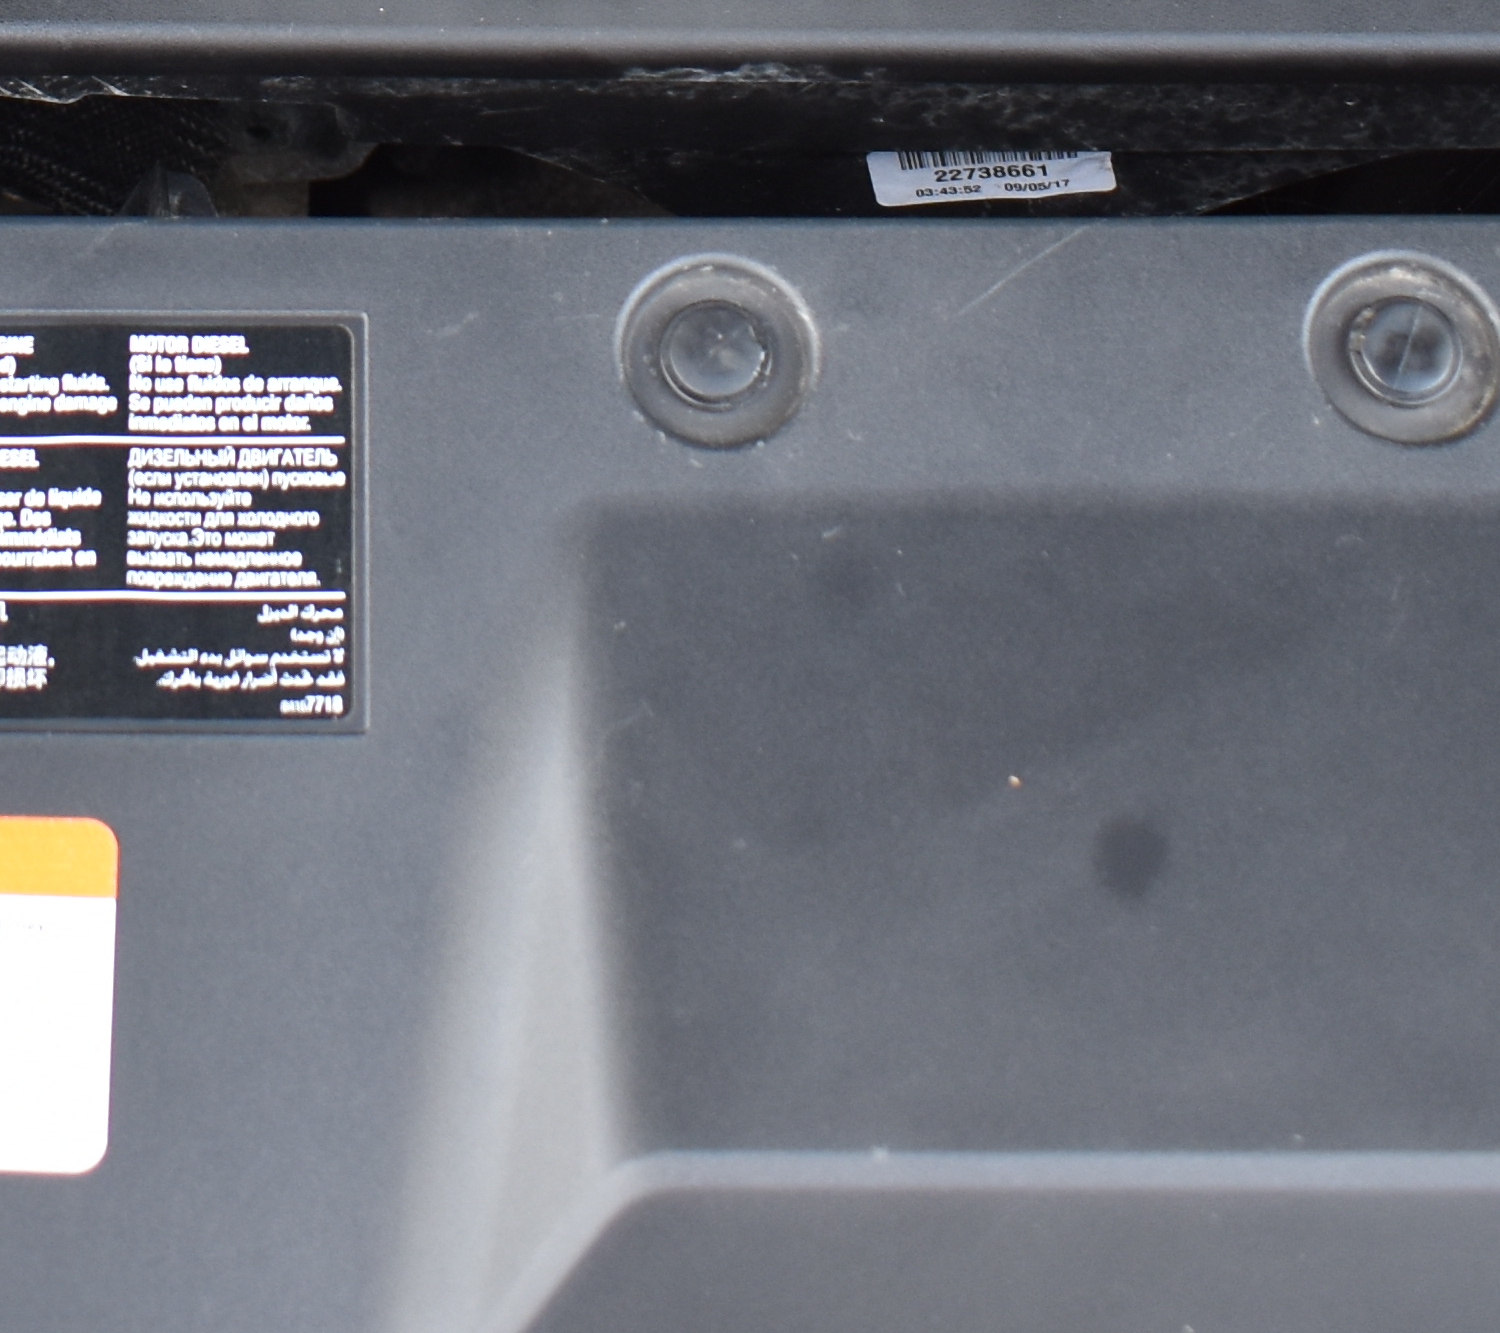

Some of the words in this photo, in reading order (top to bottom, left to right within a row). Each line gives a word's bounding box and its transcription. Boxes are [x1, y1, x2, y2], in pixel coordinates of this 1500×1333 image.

[934, 164, 1049, 183] 22738661
[915, 184, 982, 198] 03:43:52
[1004, 179, 1070, 193] 09/05/17
[129, 335, 189, 353] MOTOR
[191, 335, 250, 354] DIESEL
[61, 373, 110, 392] fluids.
[128, 374, 152, 392] No
[155, 377, 184, 392] use
[186, 374, 241, 393] fluidos
[243, 374, 264, 392] de
[267, 376, 342, 394] arranque.
[53, 394, 118, 415] damage
[128, 393, 151, 411] Se
[153, 394, 213, 414] pueden
[215, 394, 282, 414] producir
[218, 416, 239, 431] en
[242, 414, 259, 431] el
[261, 414, 311, 431] motor.
[127, 446, 236, 468] ДИЗЕЛЬНЫЙ
[237, 448, 338, 469] ДВИГАТЕЛЬ
[24, 489, 46, 507] de
[47, 488, 102, 510] liquide
[127, 488, 151, 506] Не
[19, 508, 52, 527] Des
[203, 511, 235, 529] для
[224, 531, 275, 547] может
[75, 551, 97, 567] en
